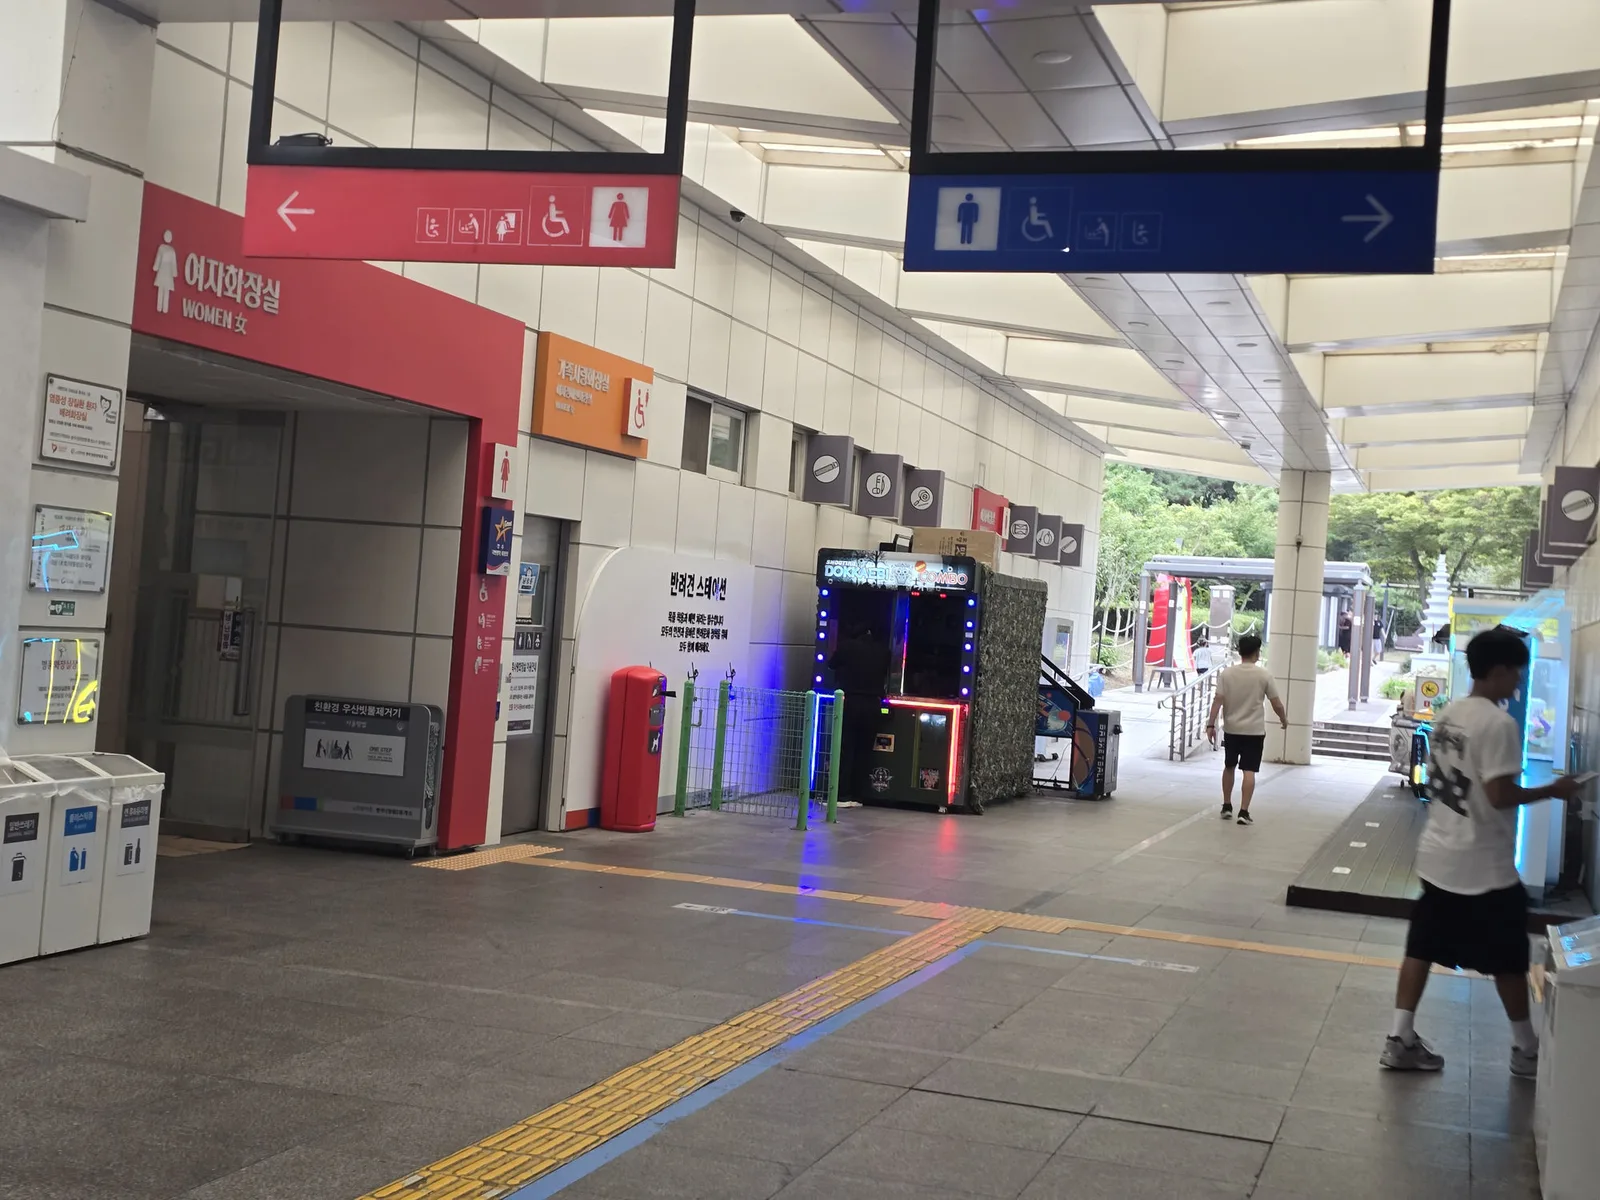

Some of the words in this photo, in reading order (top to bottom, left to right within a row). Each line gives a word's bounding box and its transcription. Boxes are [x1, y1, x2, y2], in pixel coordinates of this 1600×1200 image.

[184, 252, 280, 315] 여자화장실
[182, 297, 232, 329] WOMEN
[234, 312, 248, 335] 女
[670, 572, 695, 598] 반려견
[696, 575, 727, 601] 스테이션
[824, 565, 890, 580] DOKKAEBI
[918, 570, 968, 586] COMBO
[314, 701, 339, 713] 친환경
[343, 703, 402, 718] 우산빗물제거기
[1095, 723, 1107, 783] BASKETBALL
[9, 819, 35, 832] 일반쓰레기
